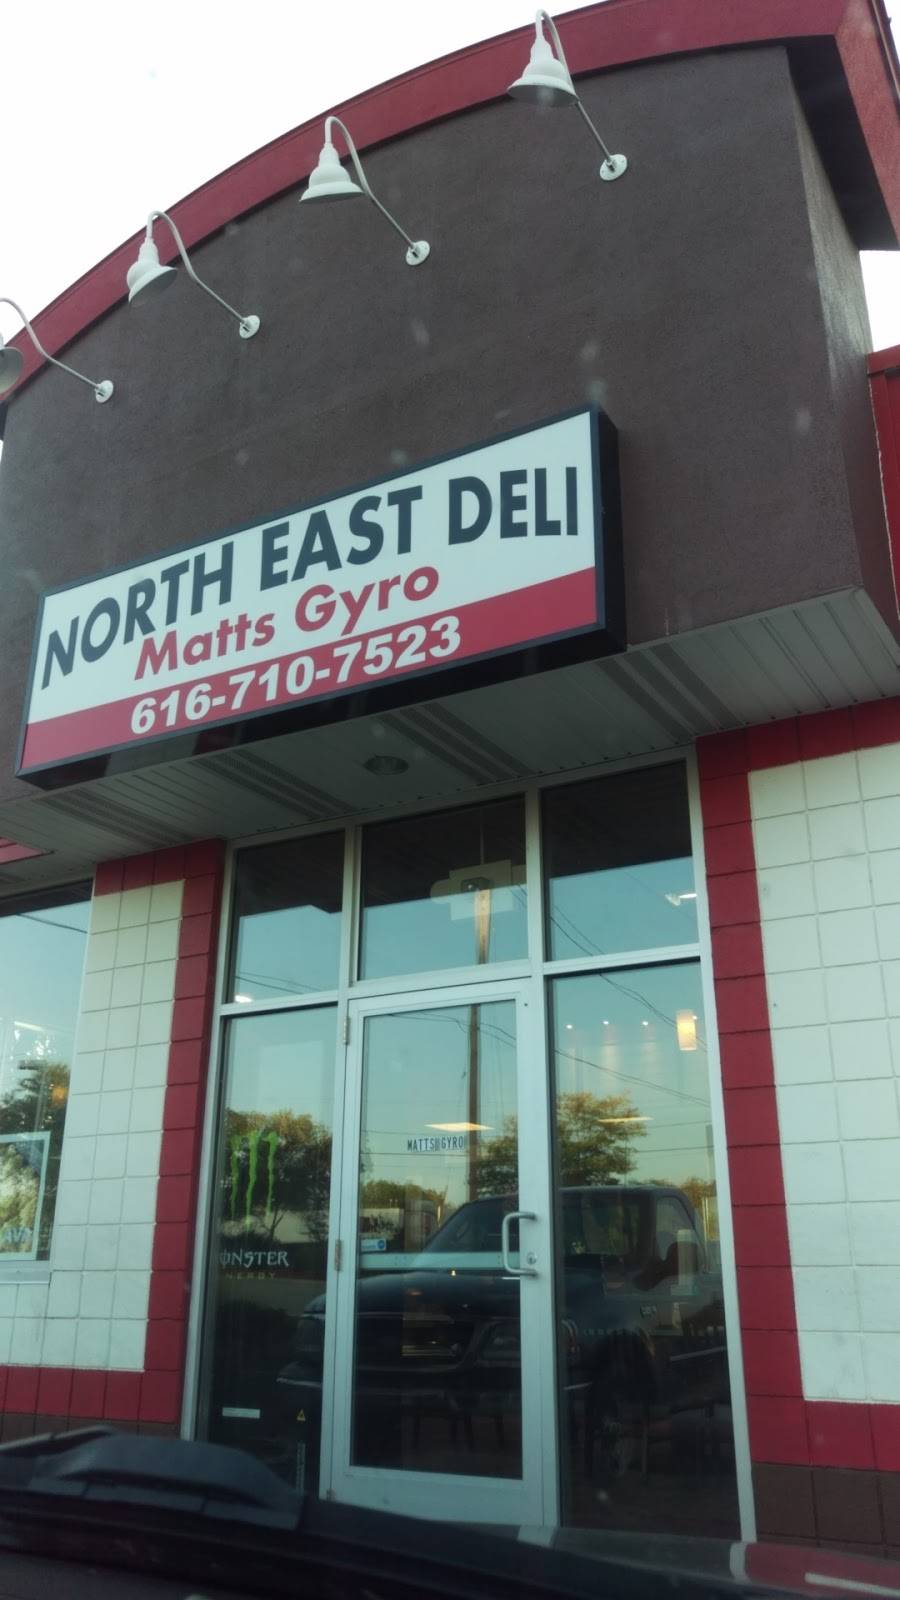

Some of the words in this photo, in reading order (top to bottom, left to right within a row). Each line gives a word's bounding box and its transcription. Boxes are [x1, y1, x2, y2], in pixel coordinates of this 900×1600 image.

[41, 541, 234, 690] NORTH
[259, 486, 423, 591] EAST
[448, 466, 579, 545] DELI
[134, 612, 276, 681] Matts
[294, 566, 439, 636] Gyro
[130, 615, 461, 735] 616-710-7523
[220, 1248, 290, 1269] ONSTER
